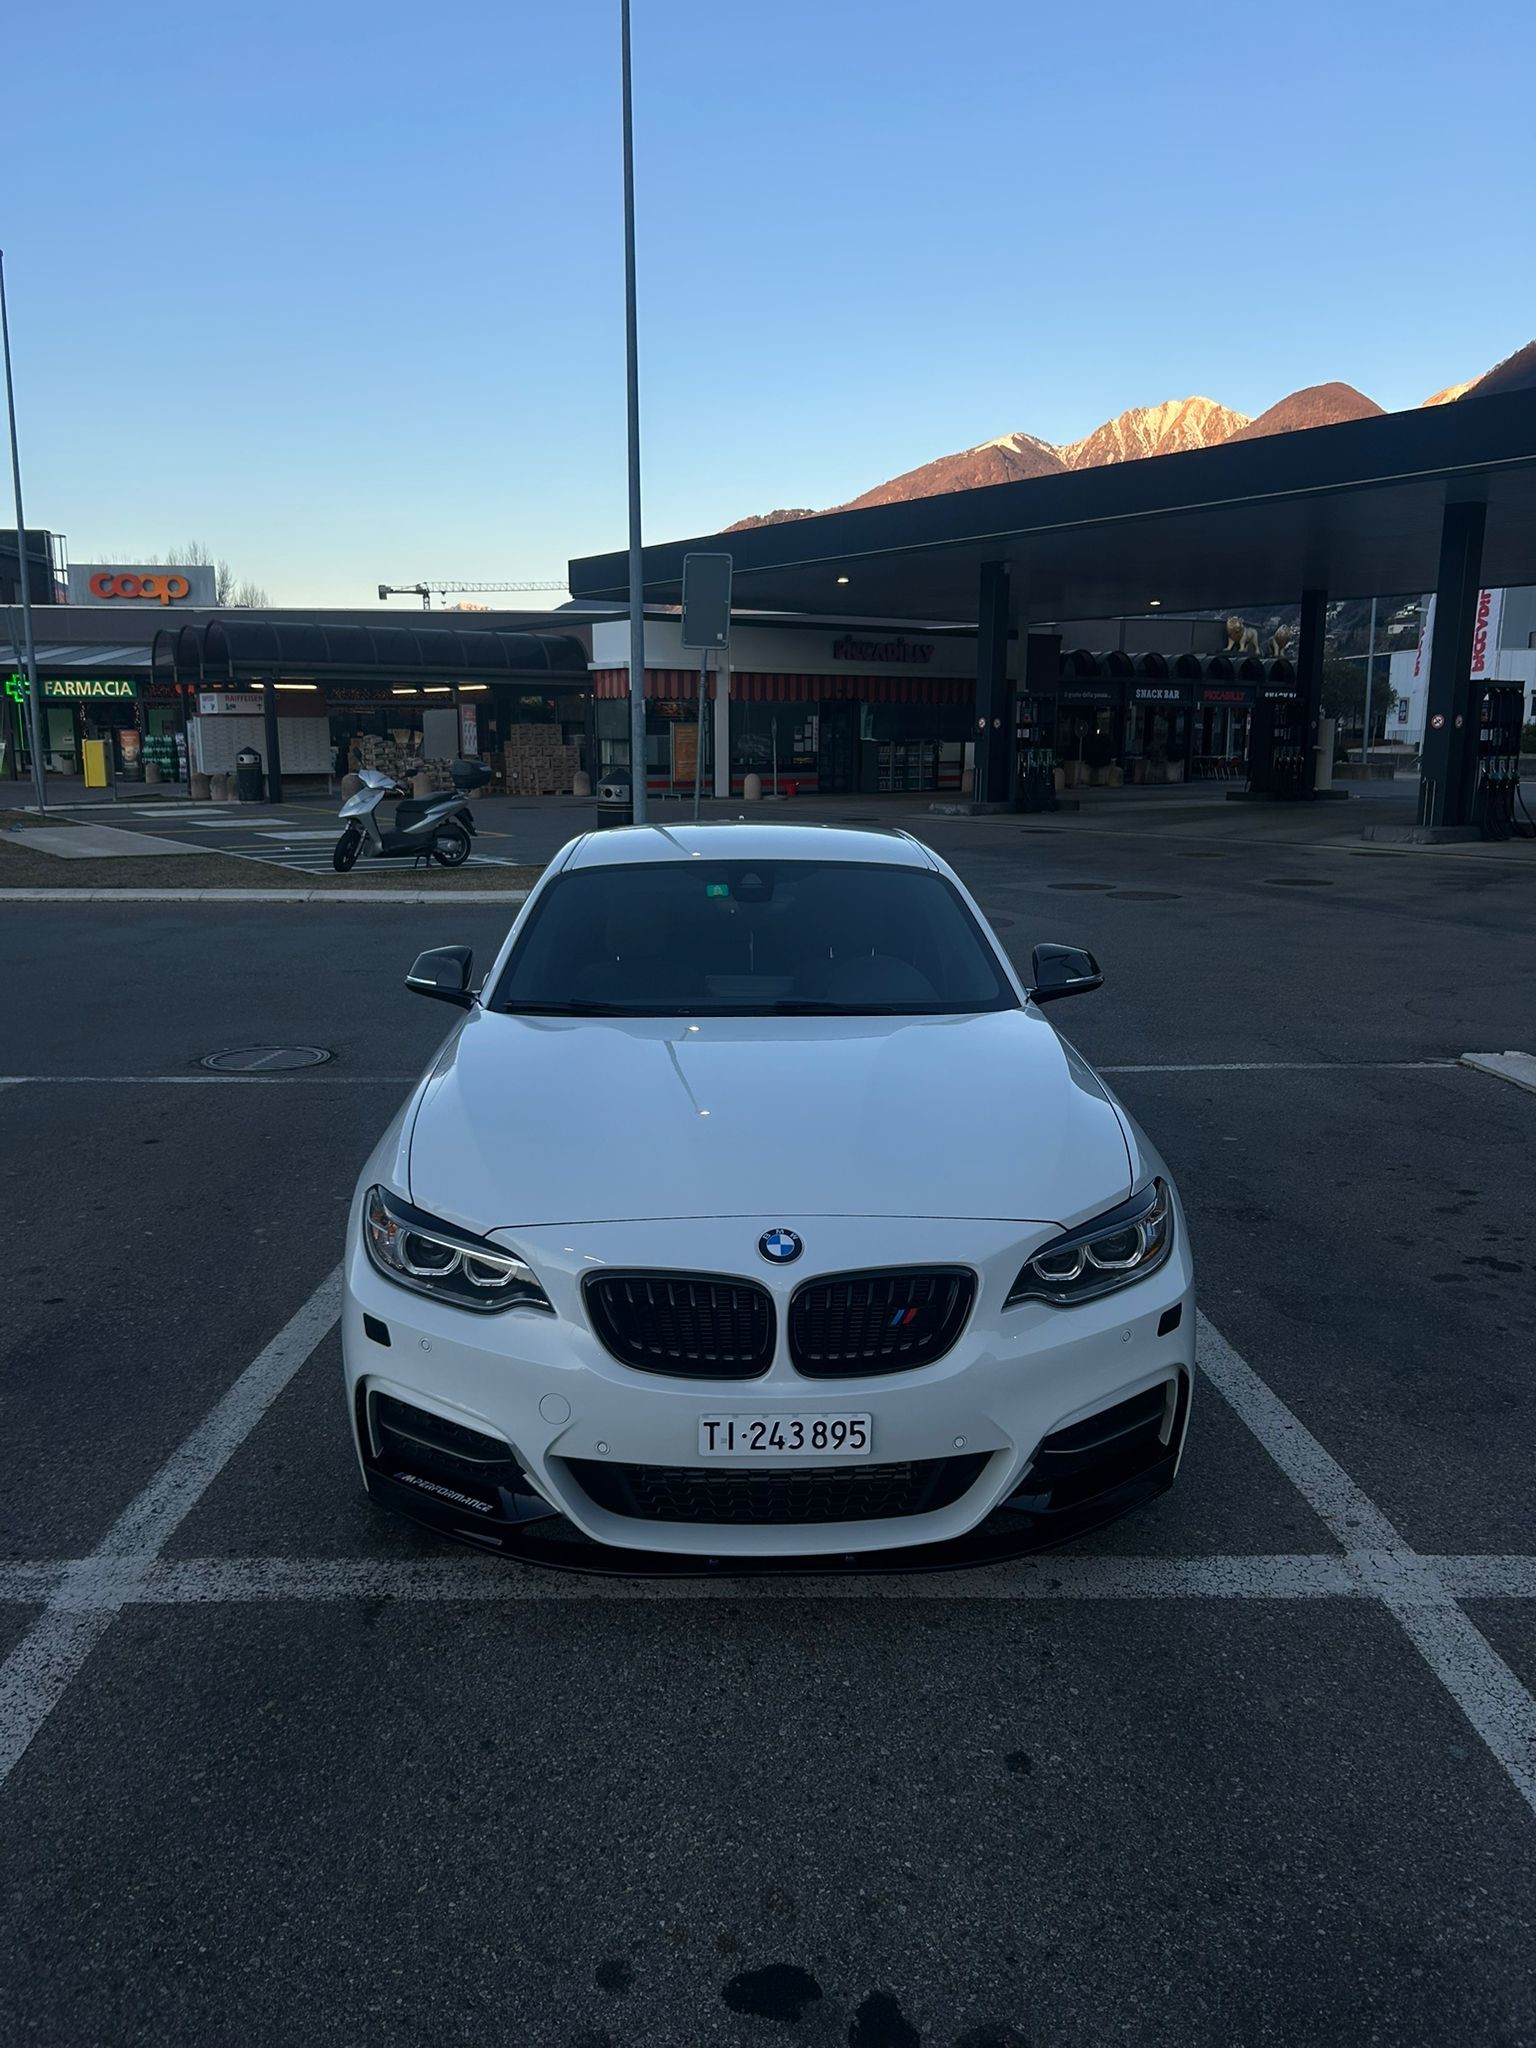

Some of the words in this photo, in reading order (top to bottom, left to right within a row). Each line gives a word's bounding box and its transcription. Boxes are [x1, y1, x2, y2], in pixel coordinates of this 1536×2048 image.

[90, 573, 190, 605] coop
[44, 681, 133, 696] FARMACIA
[1135, 688, 1163, 699] SNACK
[1164, 690, 1180, 700] BAR
[763, 1228, 799, 1240] BMW
